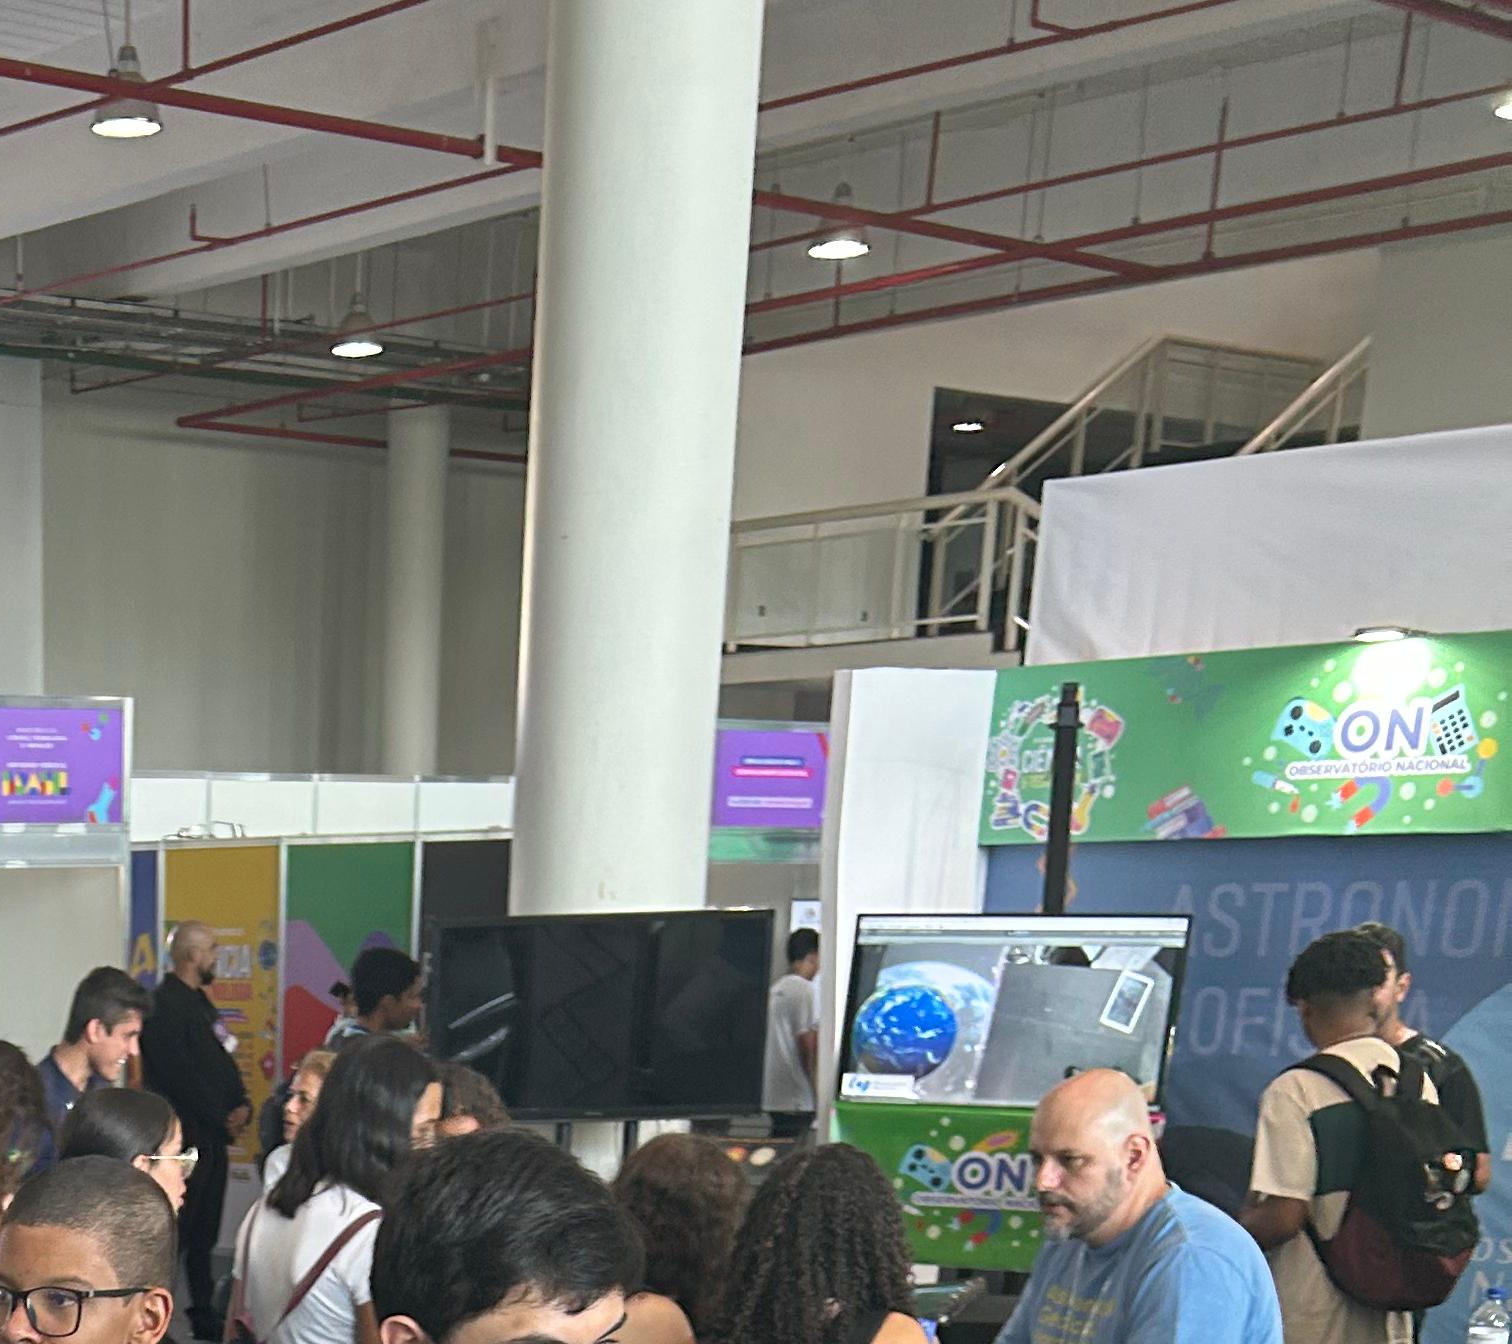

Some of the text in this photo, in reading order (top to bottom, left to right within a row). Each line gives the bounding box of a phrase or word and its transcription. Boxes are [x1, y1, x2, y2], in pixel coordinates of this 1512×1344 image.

[1340, 706, 1425, 753] ON
[1289, 758, 1468, 777] OBSERVATÓRIO NACIONAL
[956, 1155, 1028, 1192] ON
